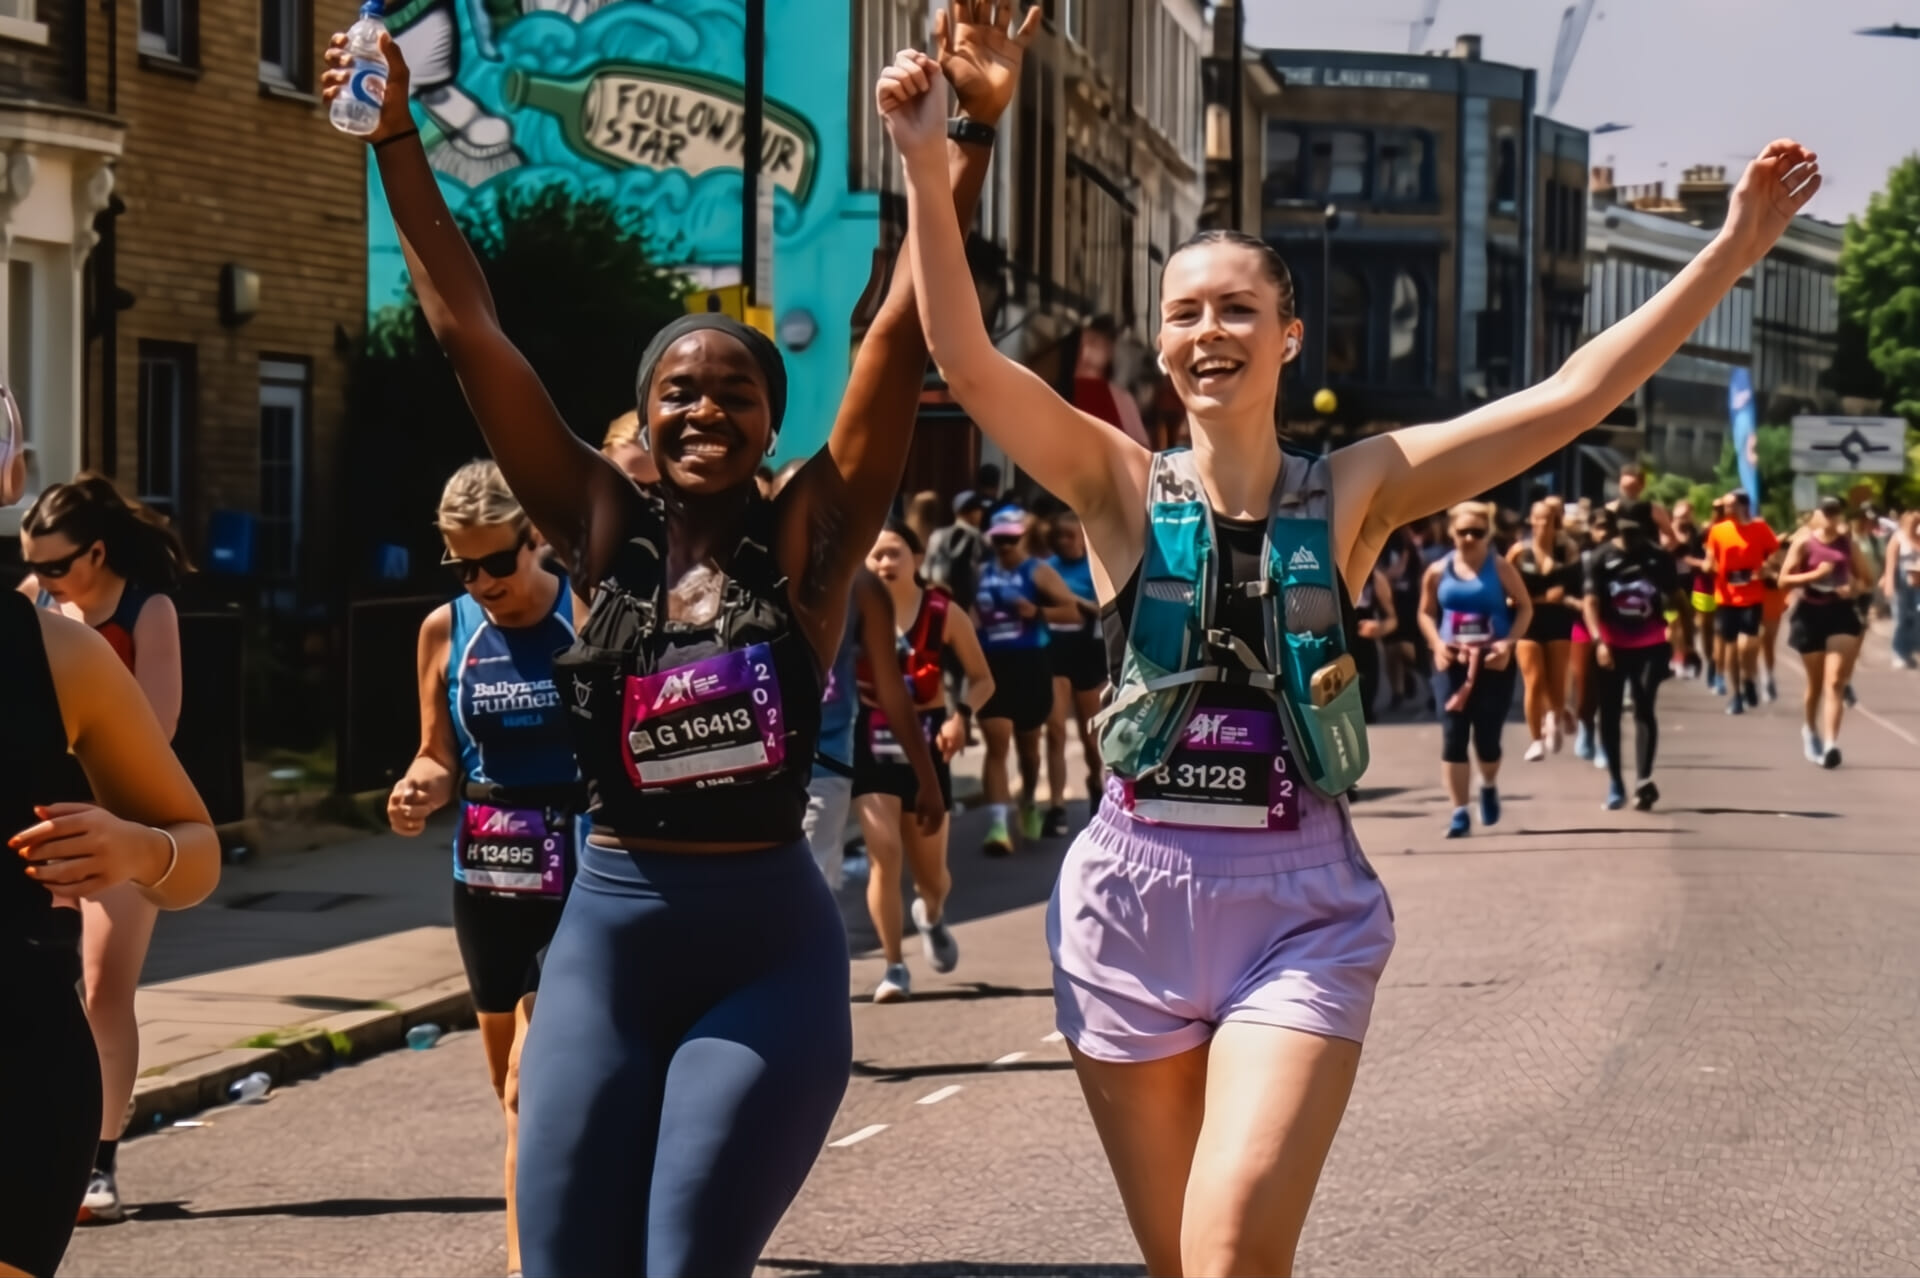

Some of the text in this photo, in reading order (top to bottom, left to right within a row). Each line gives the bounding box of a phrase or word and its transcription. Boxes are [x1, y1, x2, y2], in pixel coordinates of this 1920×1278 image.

[603, 117, 688, 167] STAR
[617, 83, 797, 173] FOLLOW YUR
[656, 708, 752, 746] G 16413
[1175, 763, 1247, 791] 3128
[466, 843, 535, 864] H 13495
